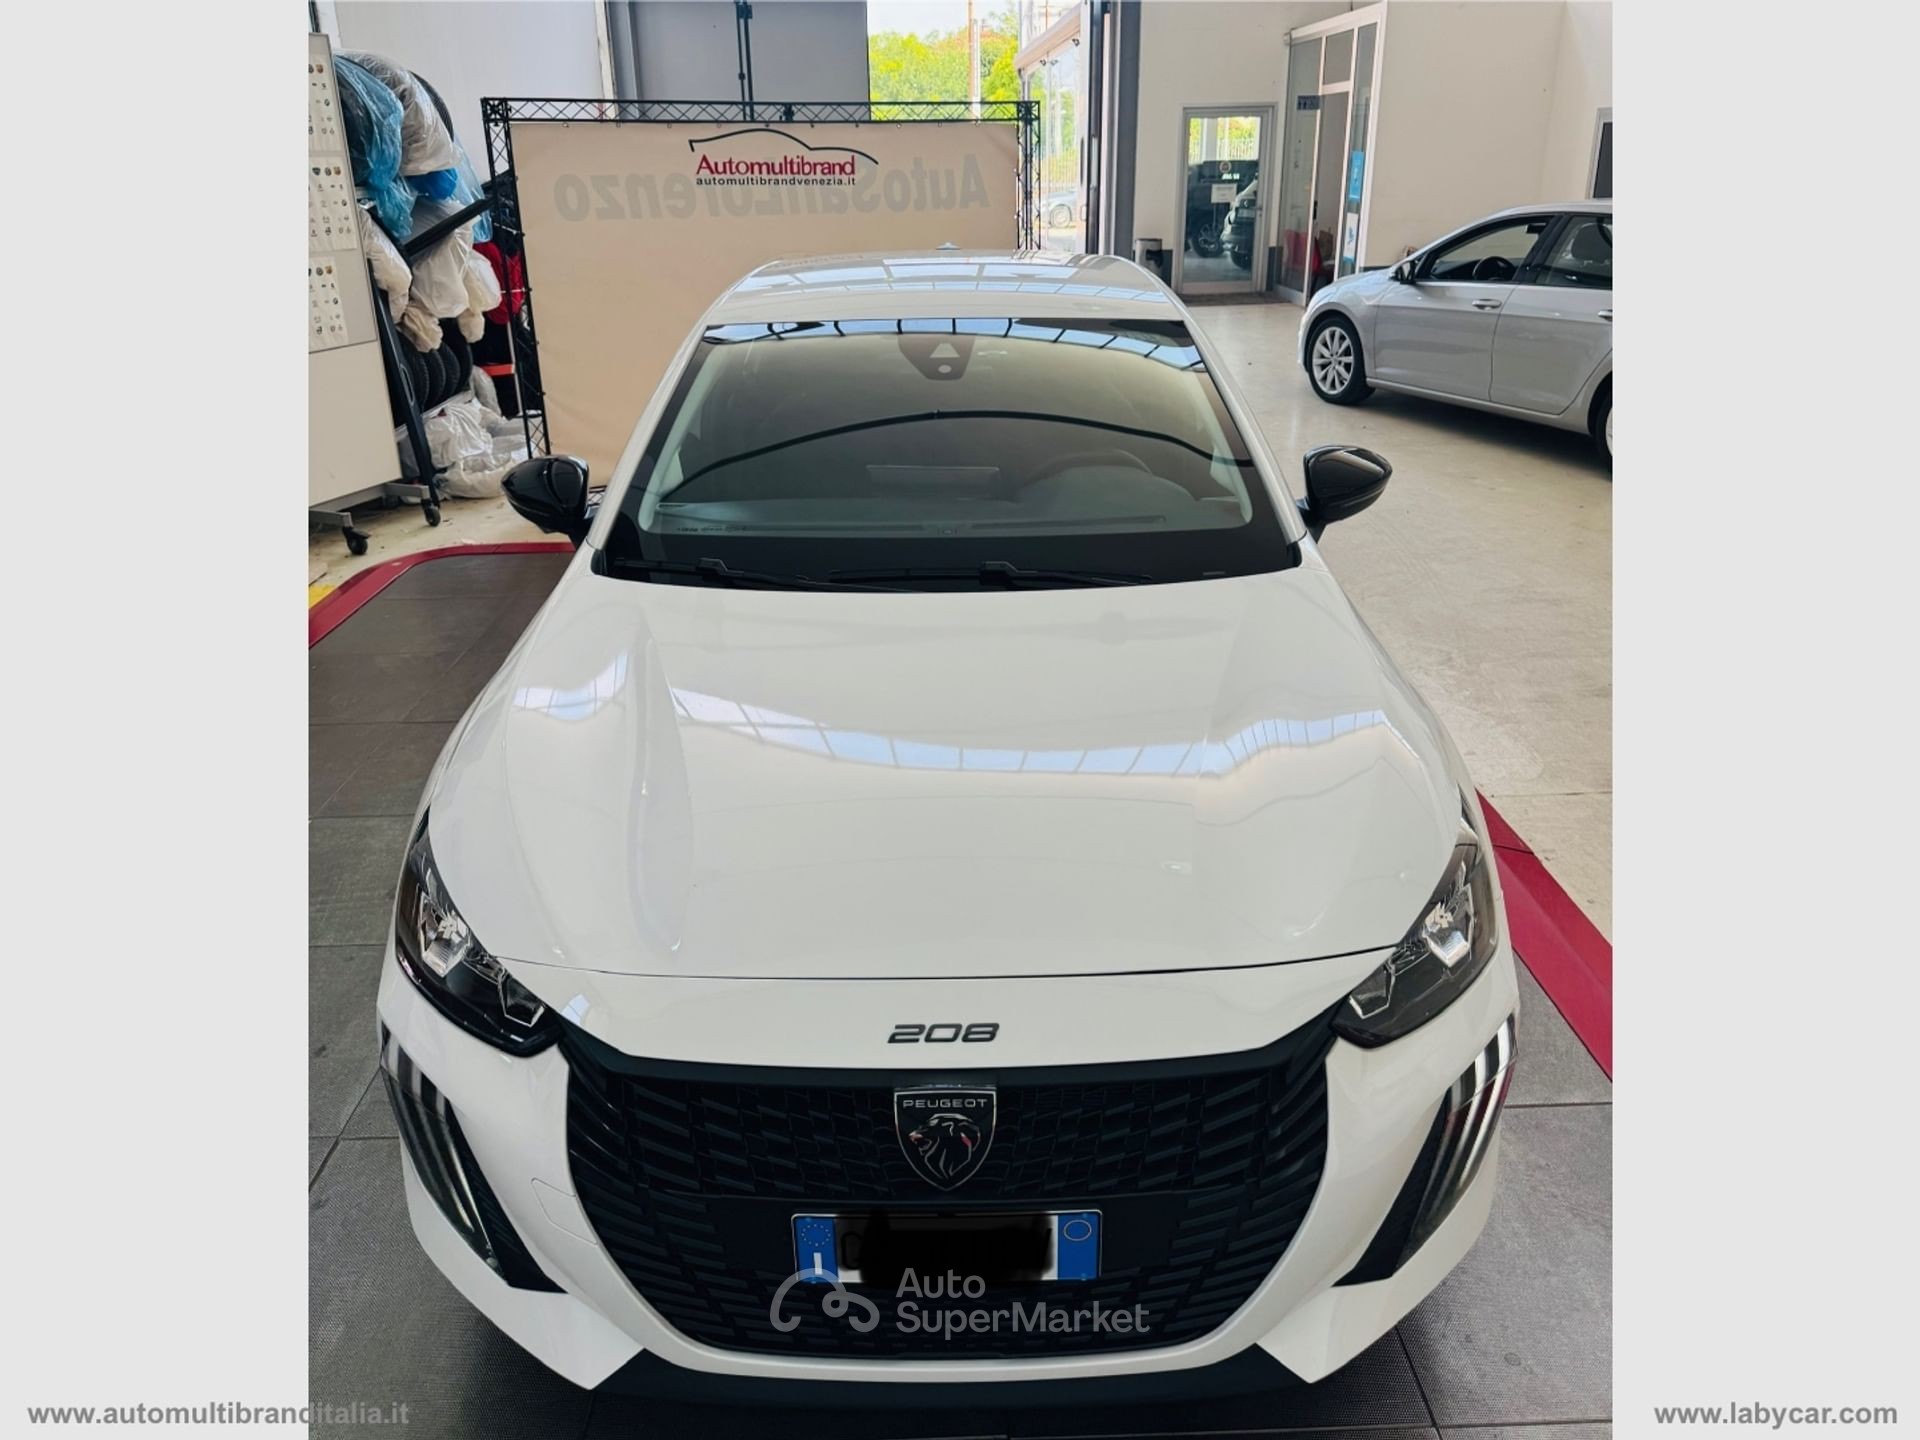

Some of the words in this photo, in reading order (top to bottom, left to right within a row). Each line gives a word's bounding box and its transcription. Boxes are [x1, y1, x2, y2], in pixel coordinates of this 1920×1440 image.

[696, 154, 855, 175] Automultibrand
[696, 176, 856, 186] automultibrandvenezia.it
[887, 1022, 1000, 1044] 208
[902, 1098, 988, 1109] PEUGEOT
